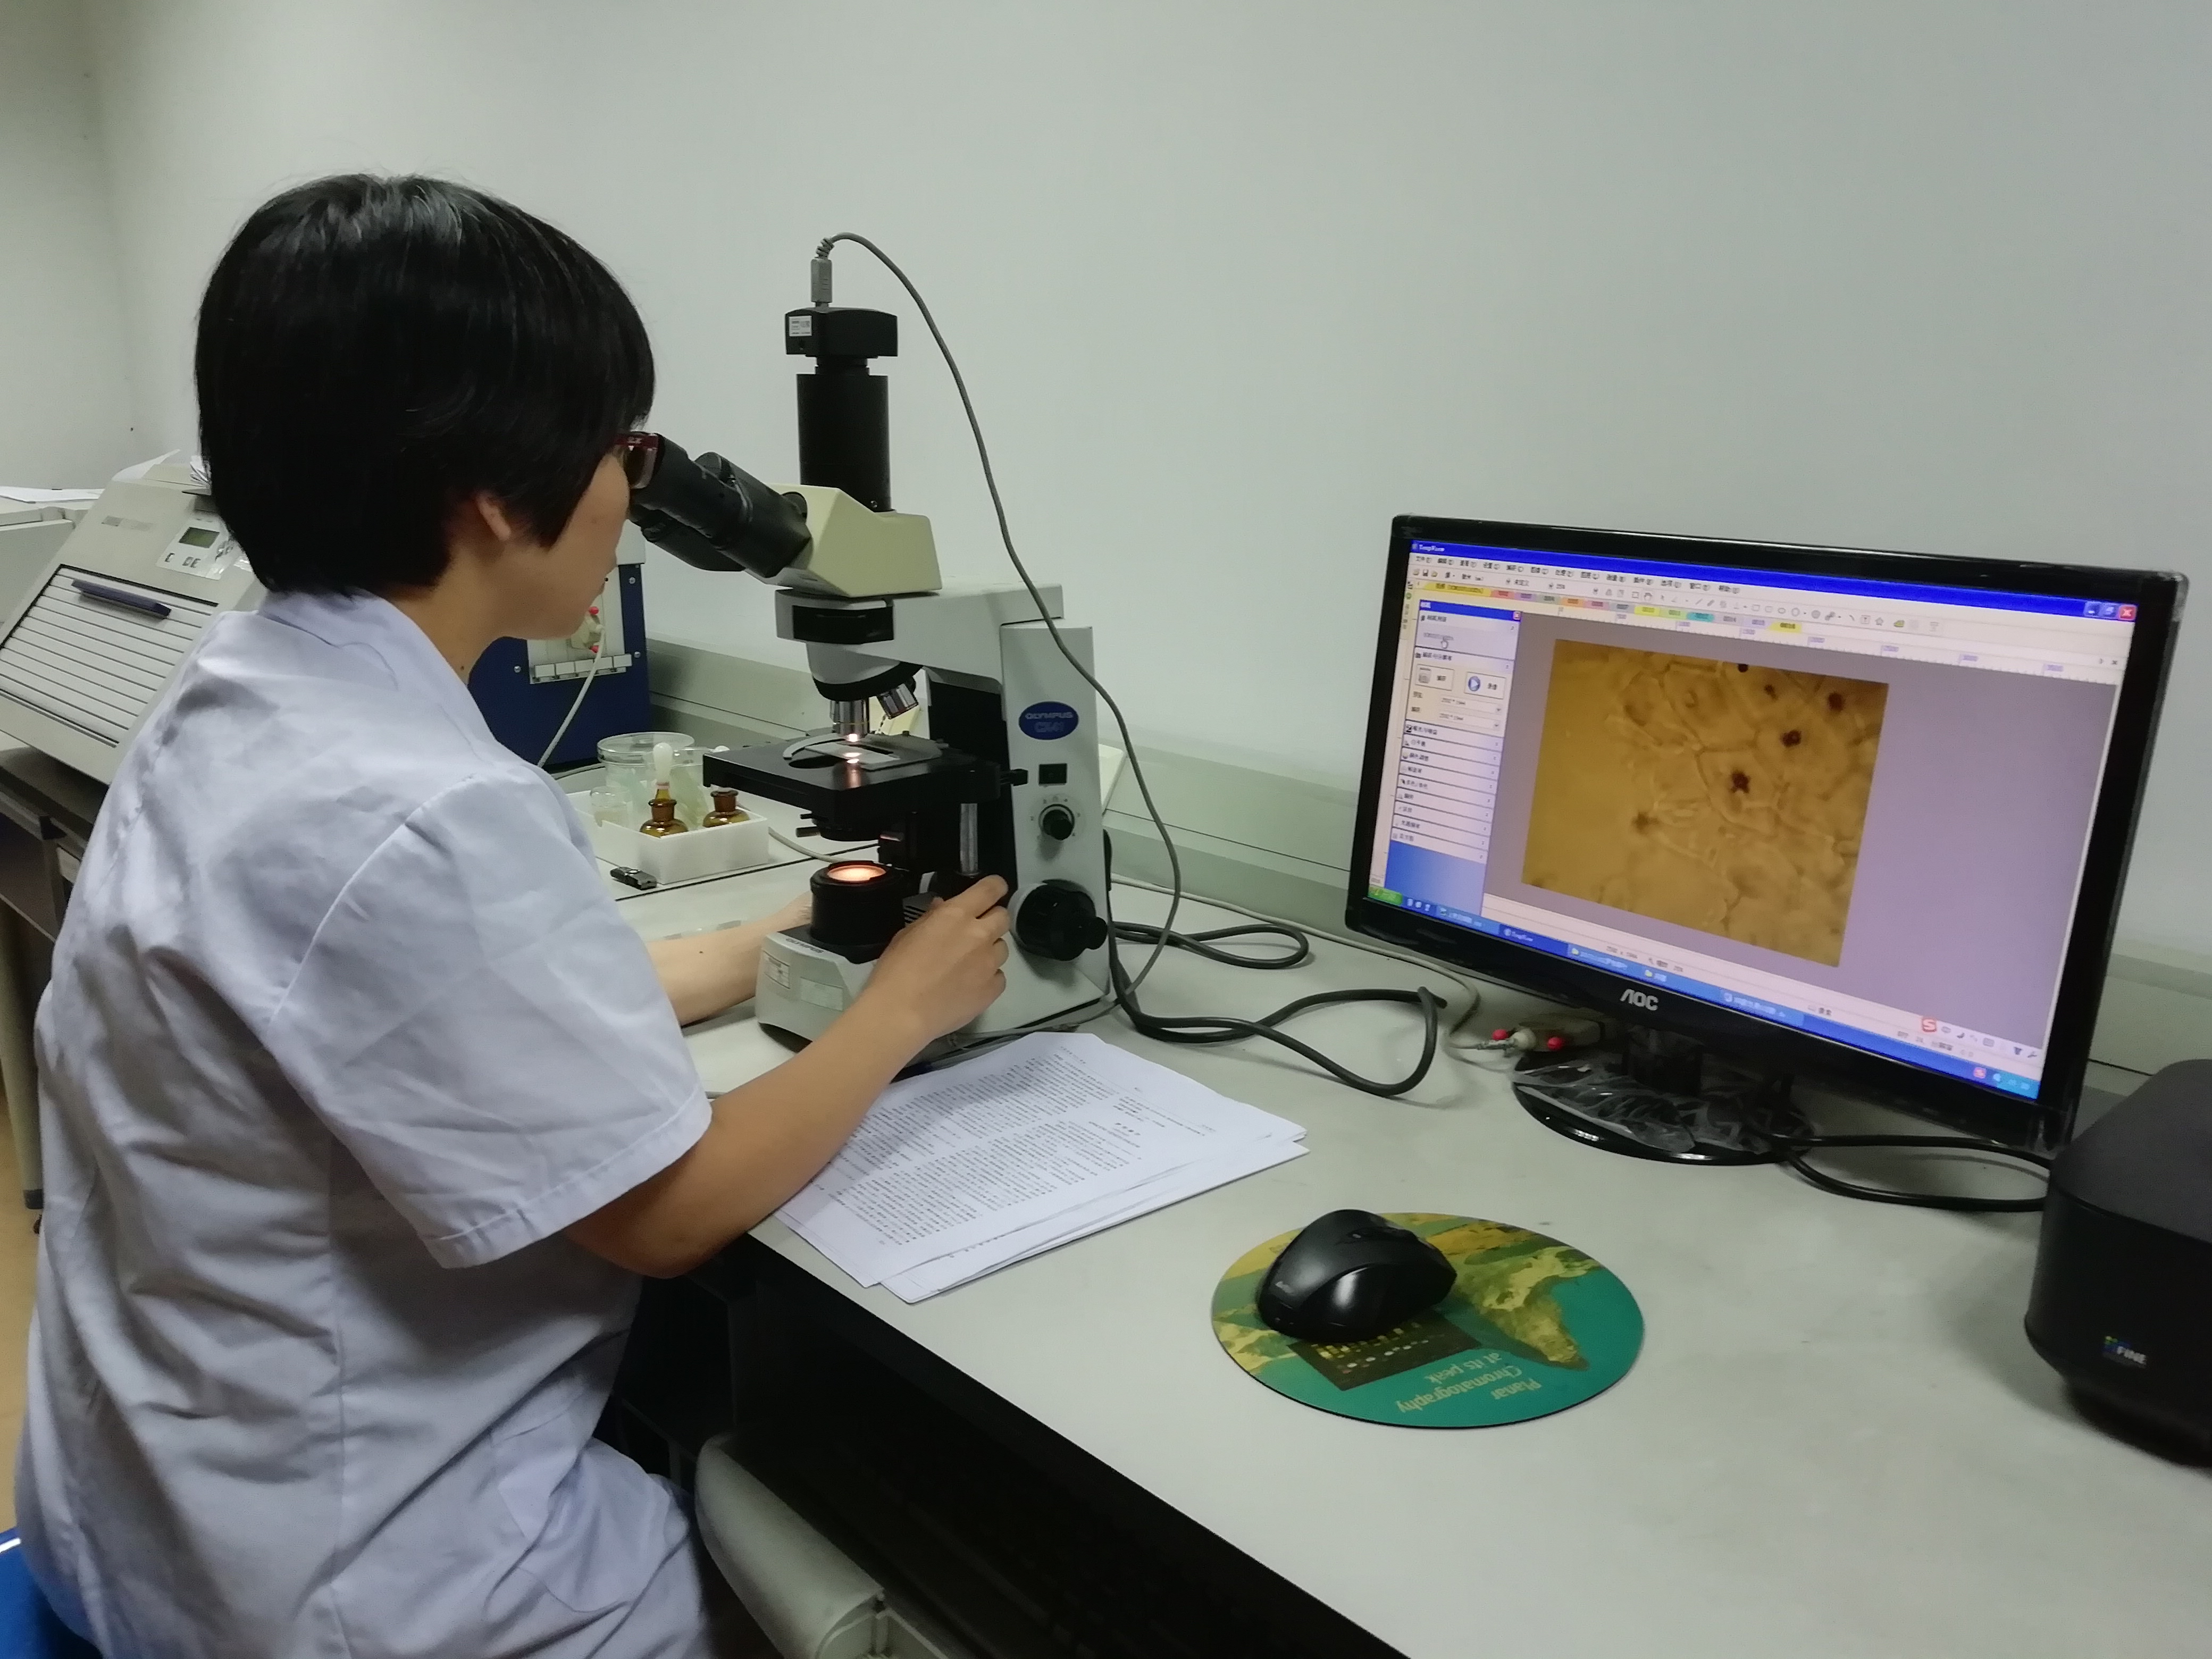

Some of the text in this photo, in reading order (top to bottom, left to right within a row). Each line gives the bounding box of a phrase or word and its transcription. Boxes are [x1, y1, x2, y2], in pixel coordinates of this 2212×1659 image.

[1620, 988, 1658, 1011] AOC
[1425, 1352, 1502, 1384] at its peak
[1396, 1365, 1522, 1413] Chromatography
[1490, 1378, 1541, 1400] Planar
